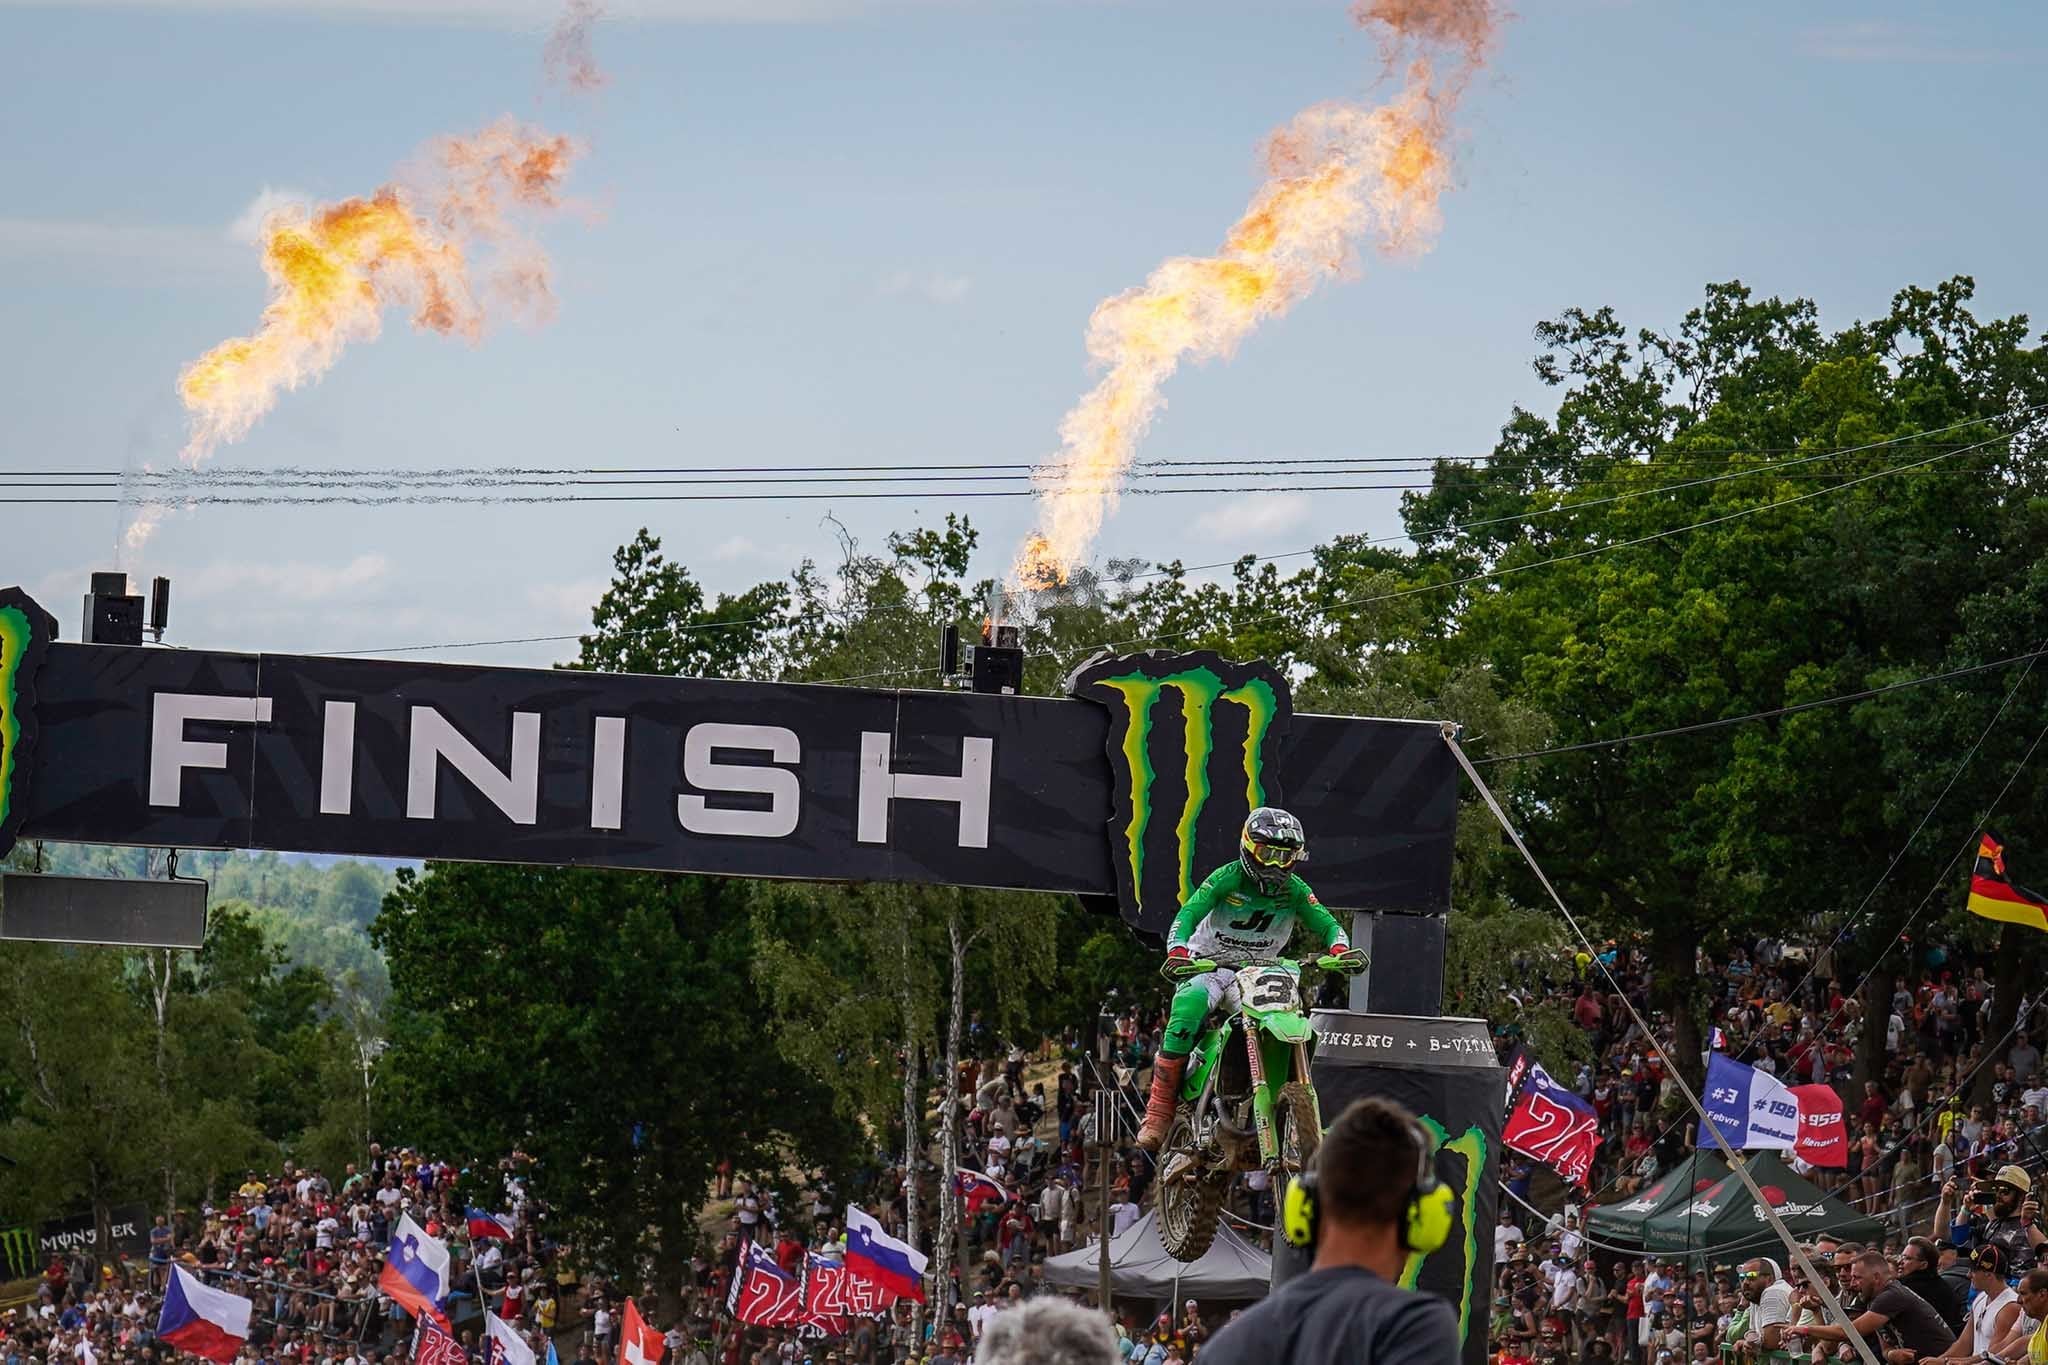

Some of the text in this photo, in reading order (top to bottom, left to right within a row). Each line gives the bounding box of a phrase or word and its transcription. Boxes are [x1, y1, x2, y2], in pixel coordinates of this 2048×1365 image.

[149, 692, 993, 849] FINISH
[1215, 931, 1274, 948] Kawasaki
[1252, 975, 1293, 1006] 3
[1711, 1087, 1739, 1104] #3
[1707, 1111, 1740, 1128] Febvre
[40, 1222, 137, 1251] MONSER
